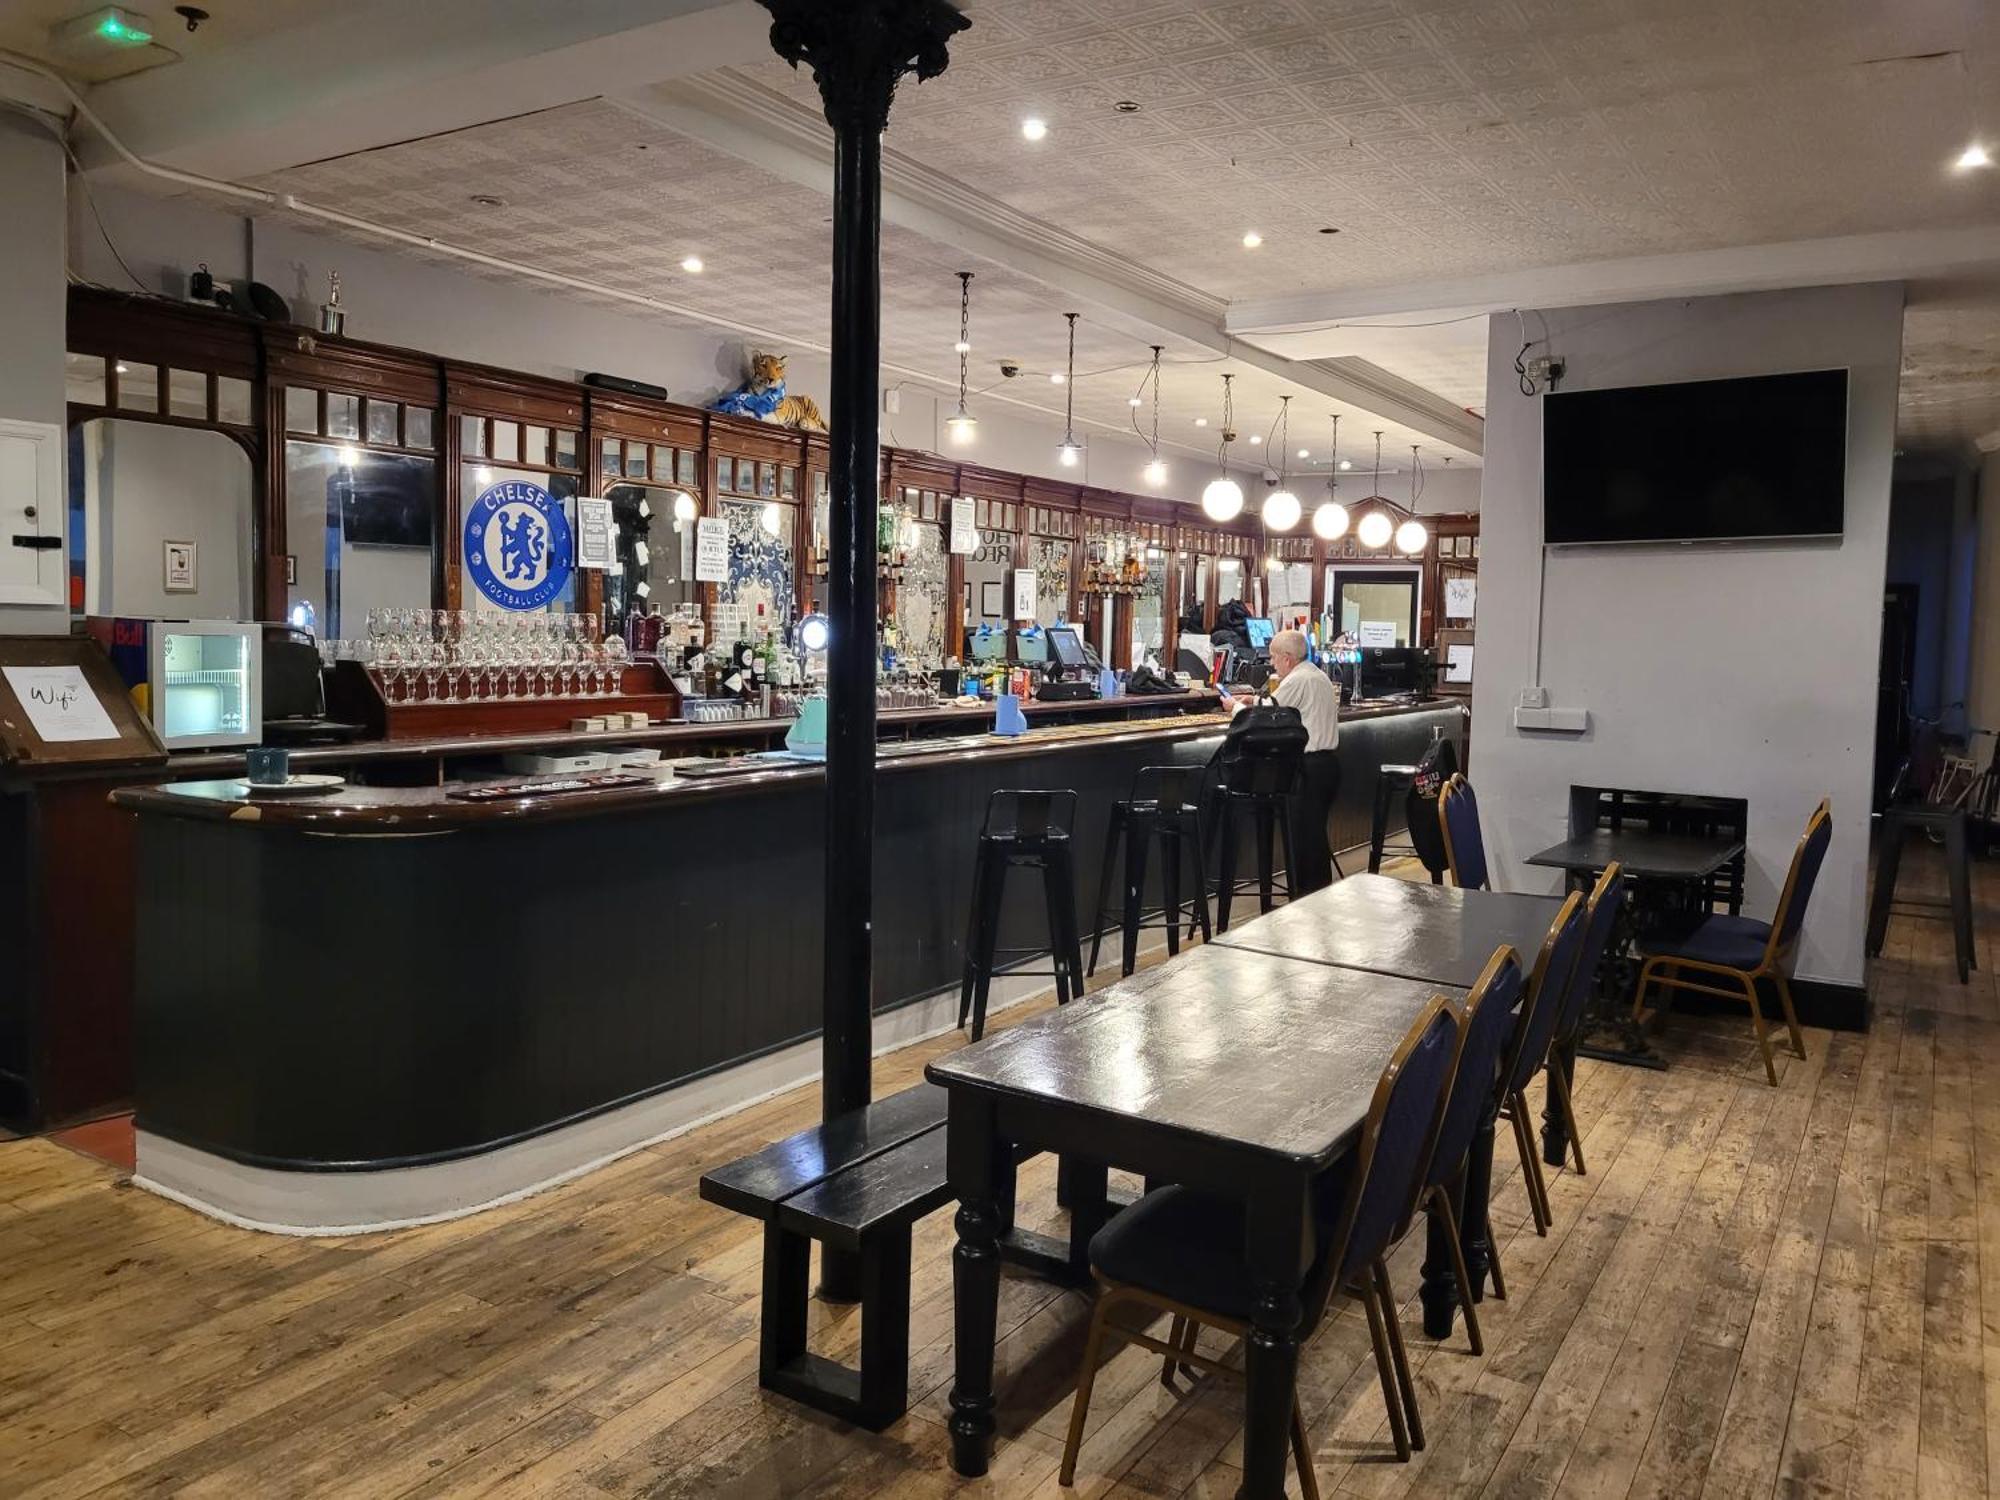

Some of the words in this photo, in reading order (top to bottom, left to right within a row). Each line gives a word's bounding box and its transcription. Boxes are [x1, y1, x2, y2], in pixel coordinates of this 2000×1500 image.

[485, 579, 531, 605] FOOTBALL
[534, 582, 554, 601] CLUB
[116, 622, 144, 646] Bull
[31, 685, 78, 710] Wifi
